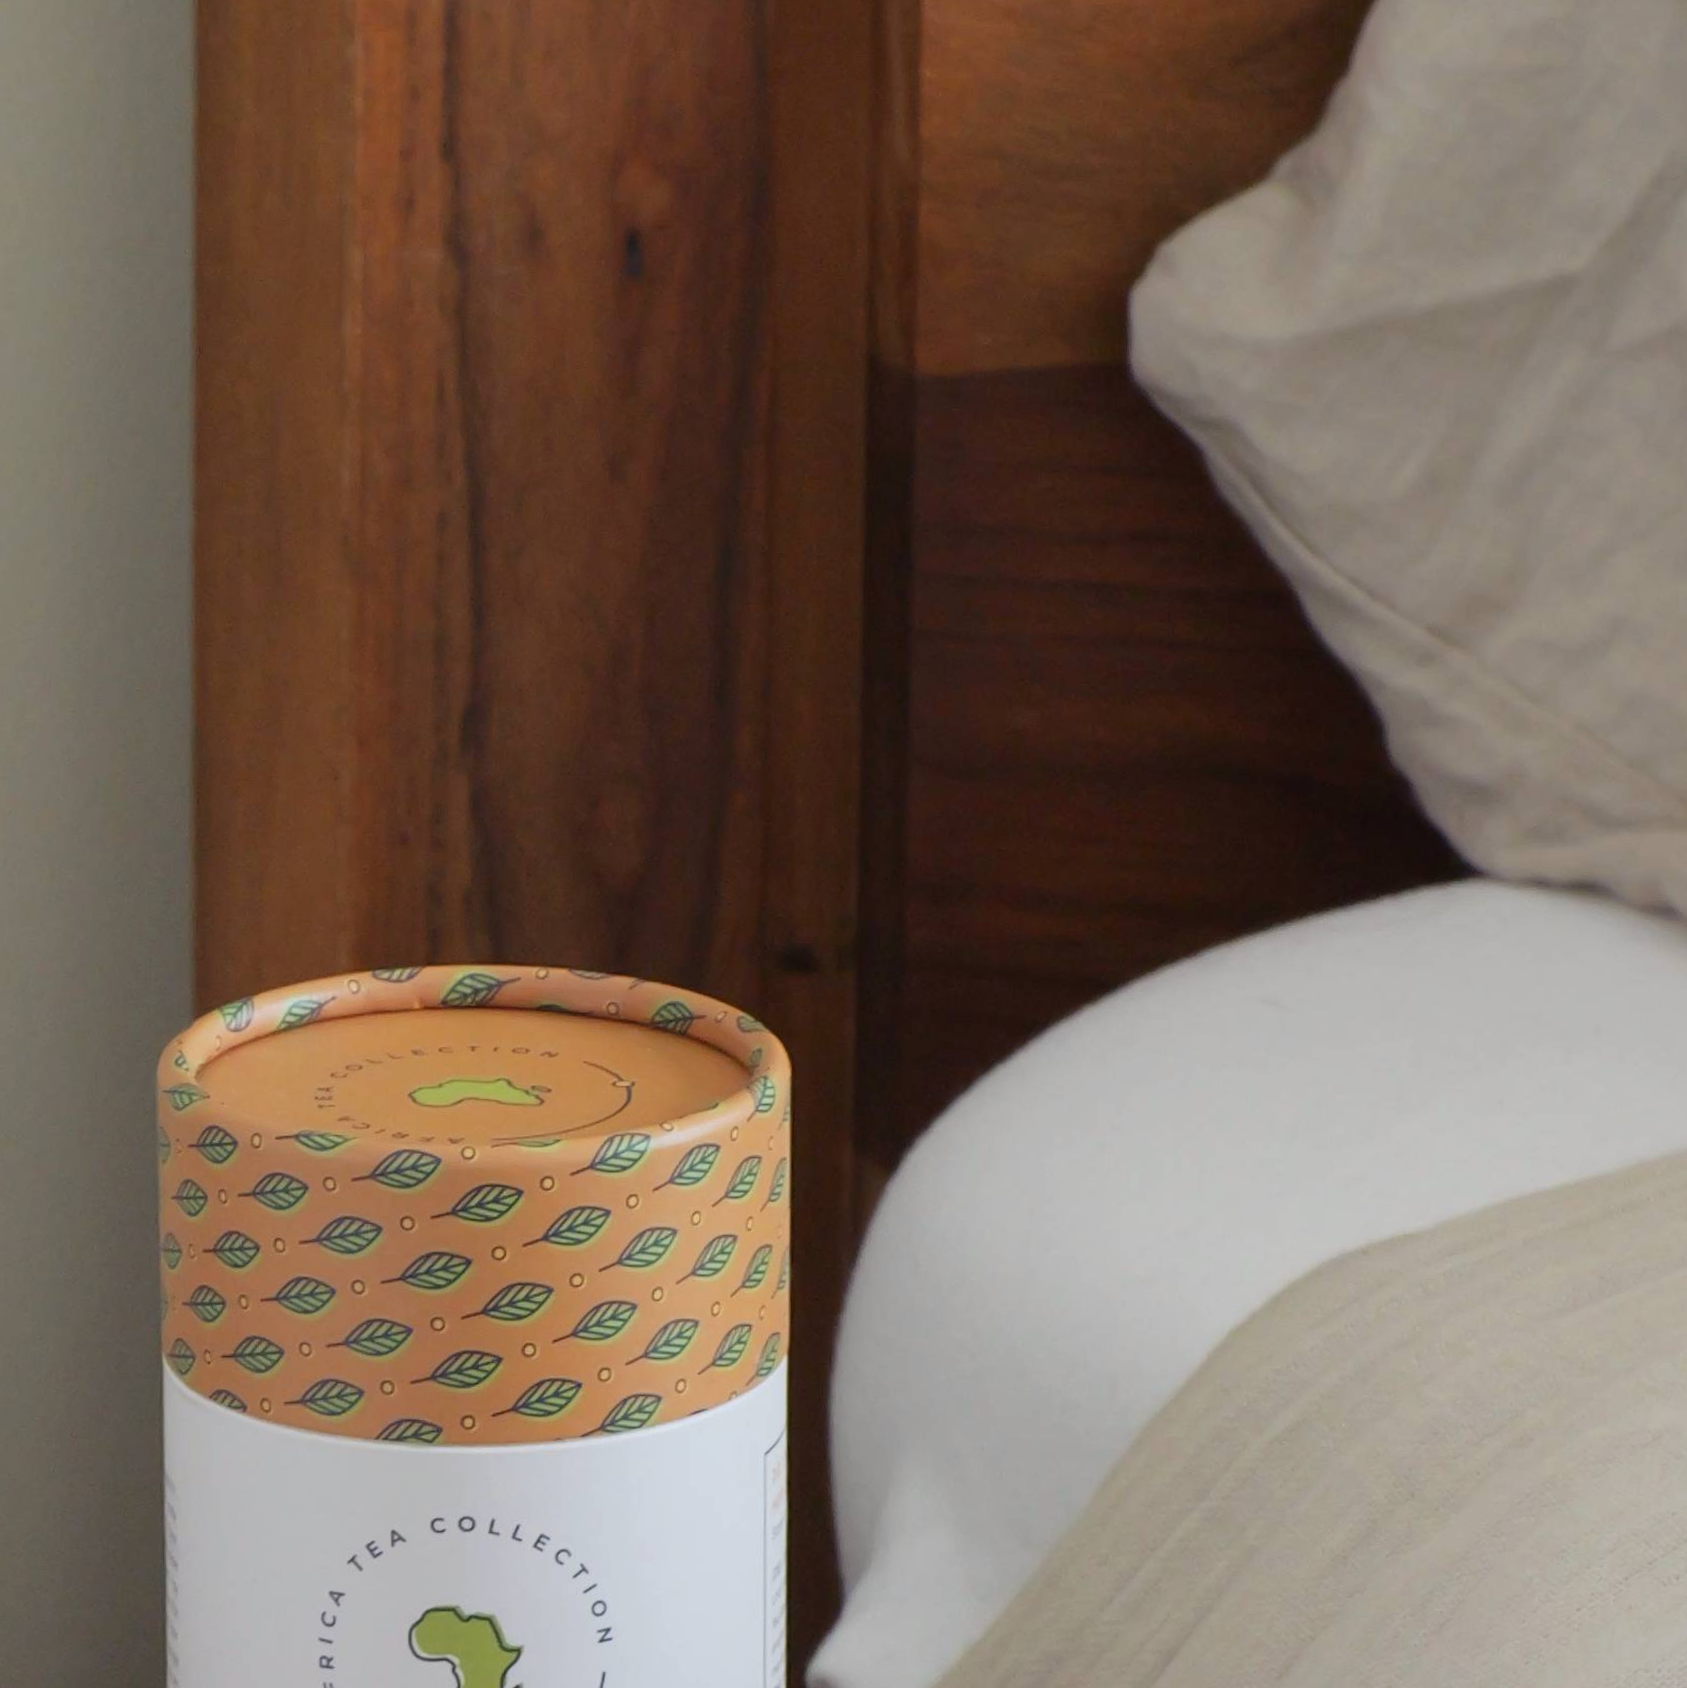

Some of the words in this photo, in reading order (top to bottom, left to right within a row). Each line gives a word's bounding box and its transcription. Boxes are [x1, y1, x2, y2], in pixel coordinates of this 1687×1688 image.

[330, 1045, 559, 1079] COLLECTION
[347, 1529, 407, 1572] TEA
[430, 1516, 613, 1645] COLLECTION
